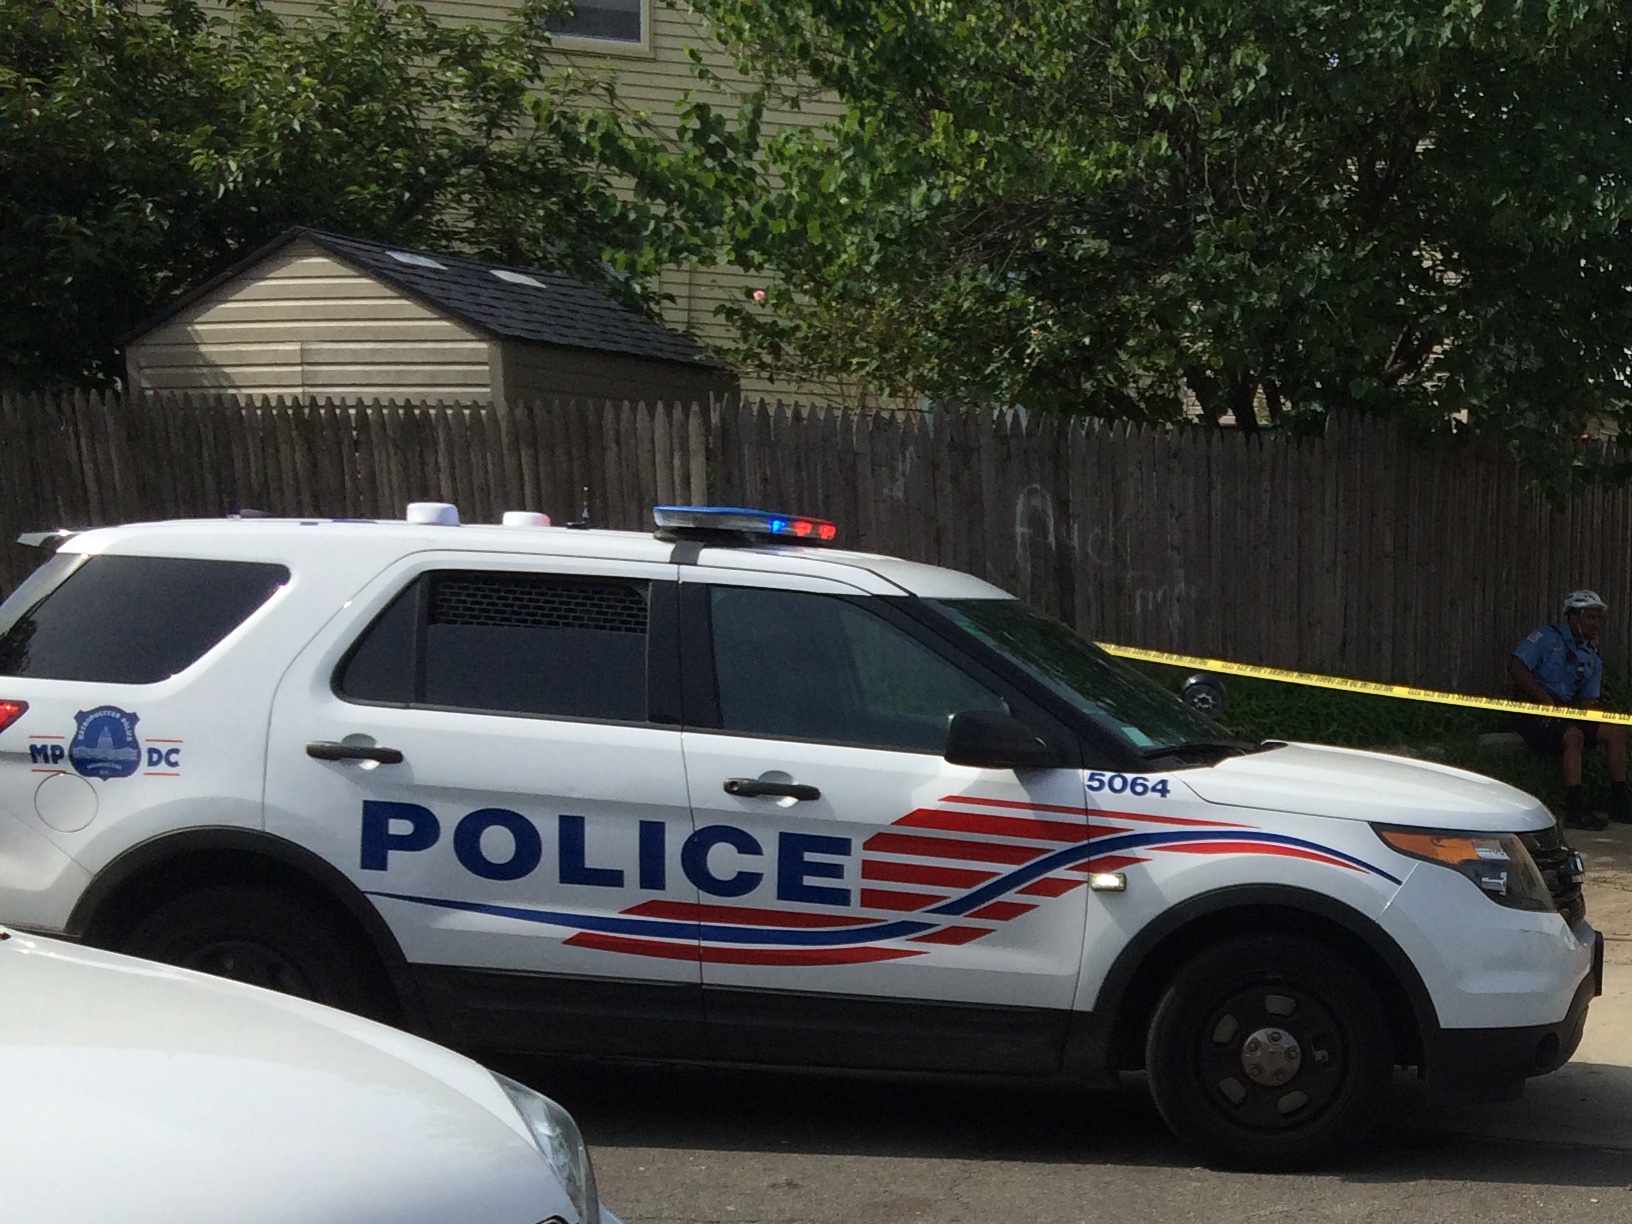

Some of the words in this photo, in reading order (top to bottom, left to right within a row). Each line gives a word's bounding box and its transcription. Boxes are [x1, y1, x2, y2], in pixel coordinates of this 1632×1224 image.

[29, 744, 65, 764] MP
[146, 747, 181, 768] DC
[1086, 772, 1171, 798] 5064
[359, 800, 852, 907] POLICE
